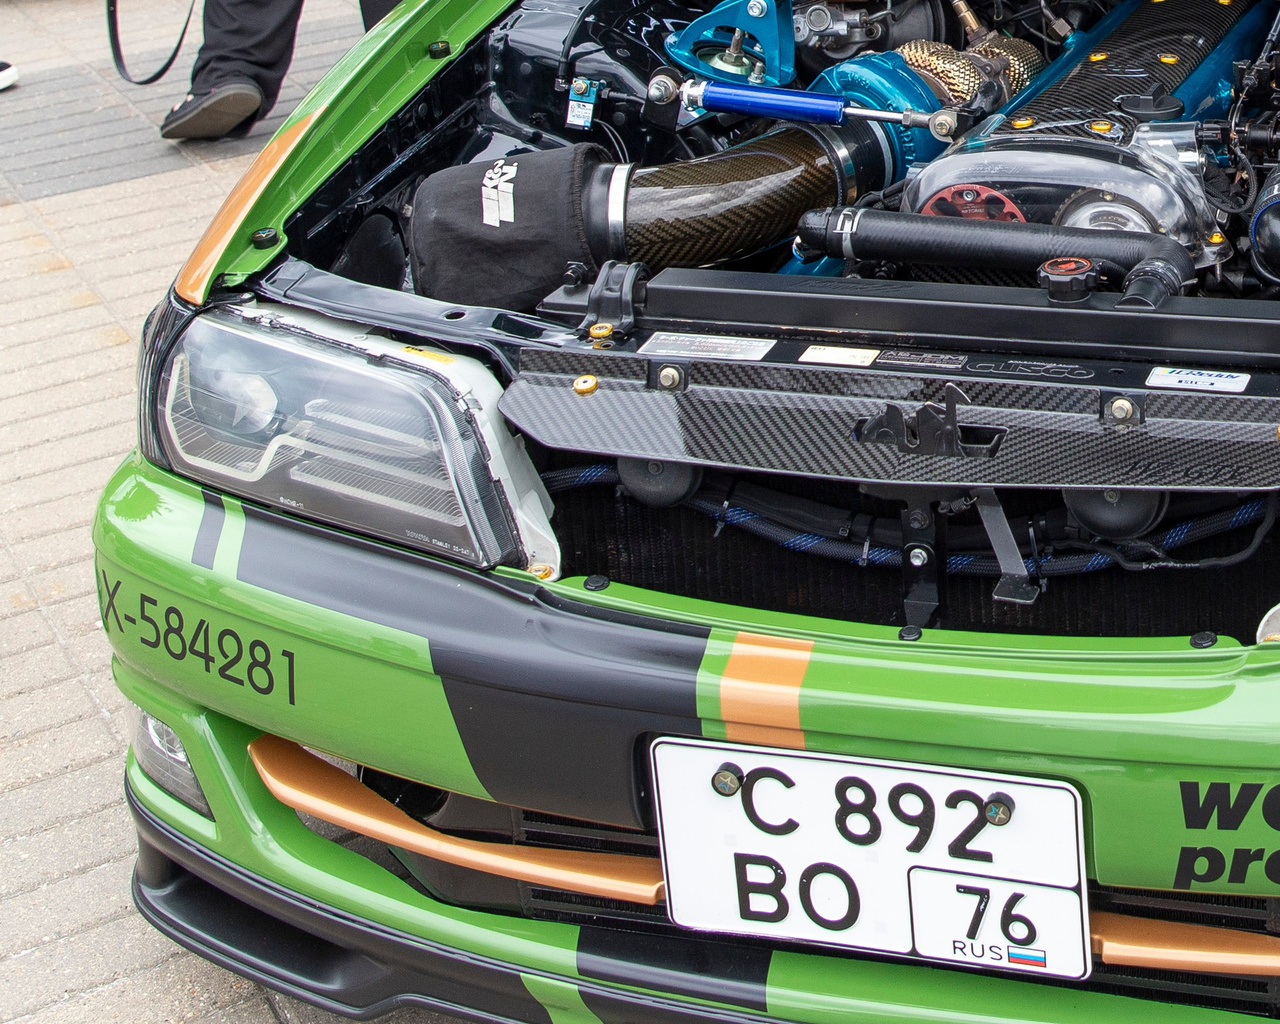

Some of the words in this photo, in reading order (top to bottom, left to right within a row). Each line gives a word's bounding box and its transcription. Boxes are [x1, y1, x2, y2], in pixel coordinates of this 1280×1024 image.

[102, 568, 297, 707] X-584281
[835, 776, 993, 862] 892
[951, 939, 1003, 962] RUS
[955, 883, 1038, 947] 76
